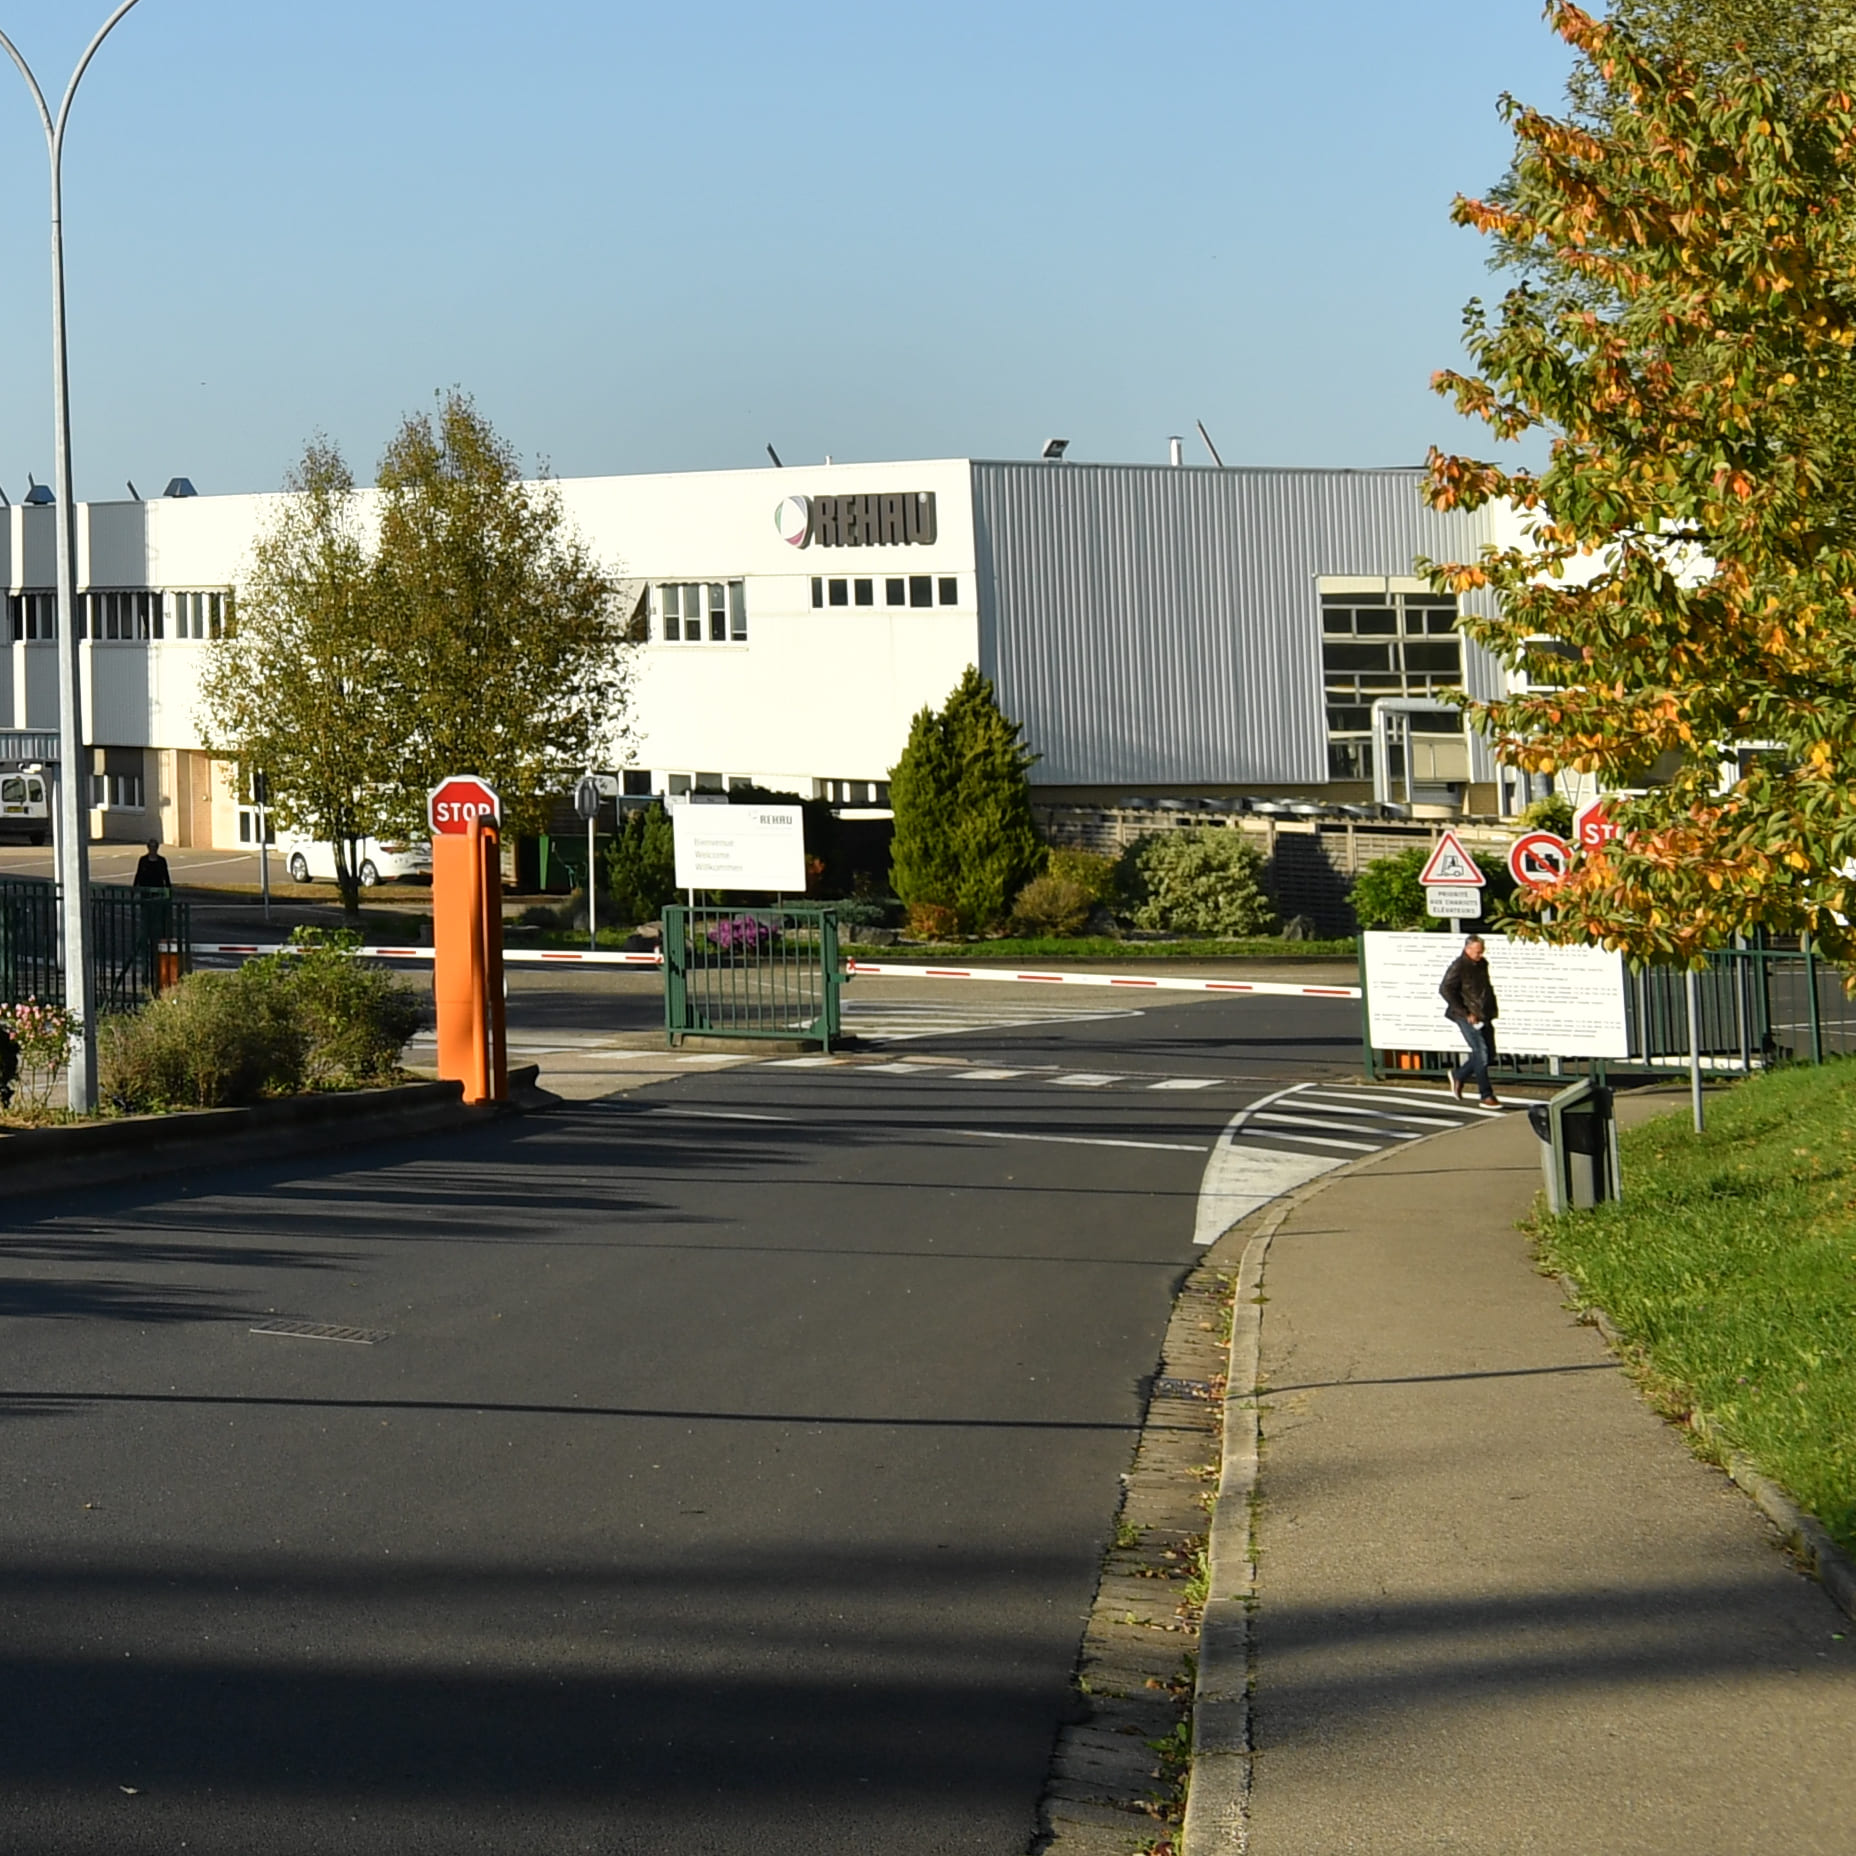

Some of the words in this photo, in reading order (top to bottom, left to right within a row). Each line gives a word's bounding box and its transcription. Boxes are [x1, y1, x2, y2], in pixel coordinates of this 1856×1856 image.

[813, 491, 937, 547] REHAU
[436, 802, 491, 822] STOP
[760, 815, 793, 825] REHAU
